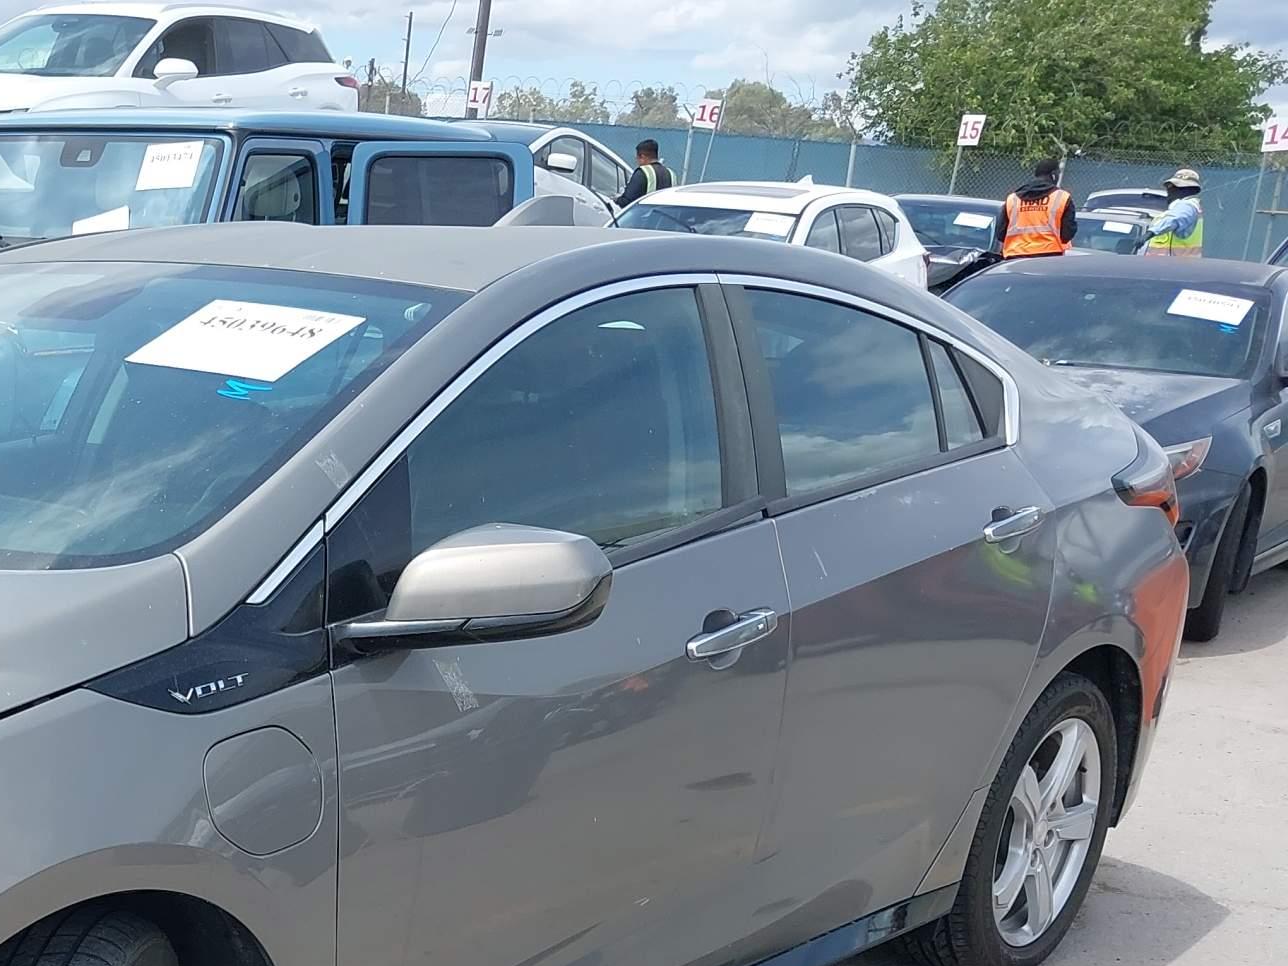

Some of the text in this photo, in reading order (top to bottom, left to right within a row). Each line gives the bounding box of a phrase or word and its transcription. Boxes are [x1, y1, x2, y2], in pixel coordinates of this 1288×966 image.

[469, 87, 490, 104] 17
[695, 104, 720, 123] 16
[960, 120, 982, 140] 15
[168, 673, 249, 704] VOLT
